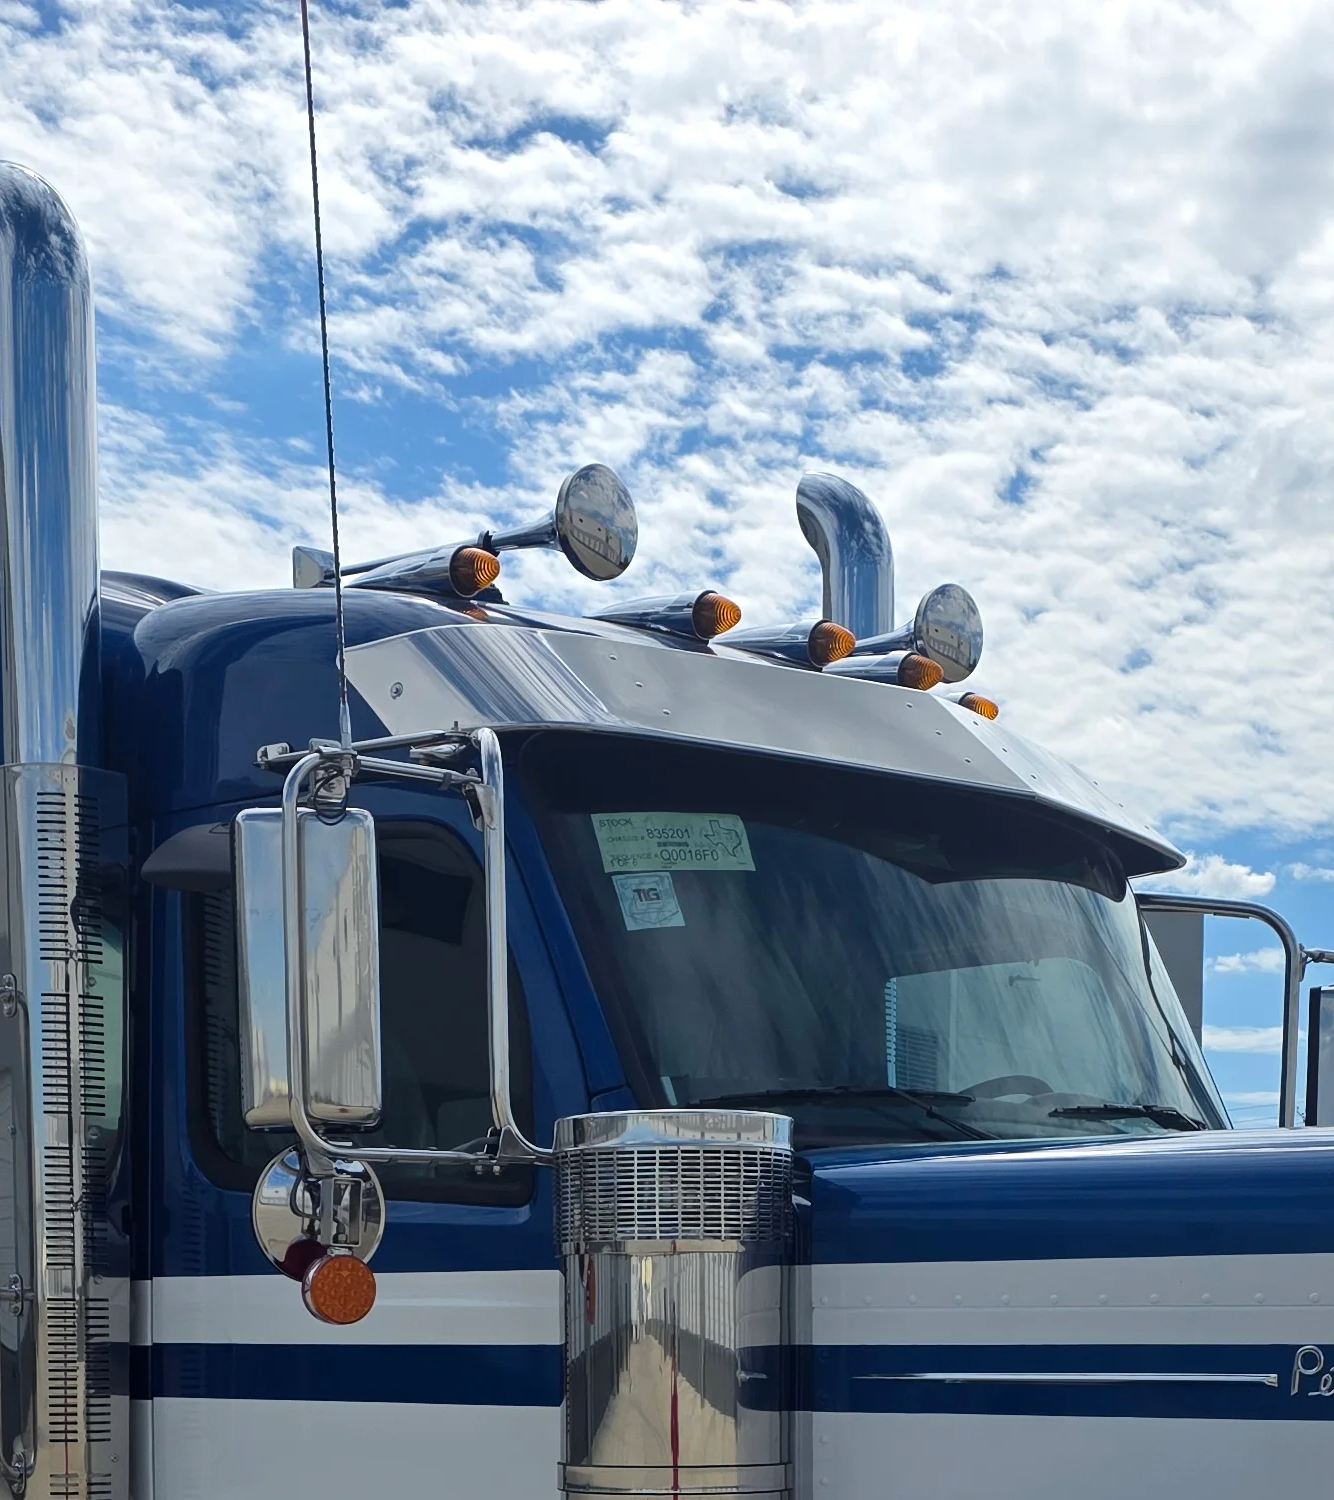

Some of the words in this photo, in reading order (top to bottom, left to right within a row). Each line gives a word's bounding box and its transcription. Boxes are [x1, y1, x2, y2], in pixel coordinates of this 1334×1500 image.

[599, 818, 633, 828] STOCK
[646, 828, 690, 839] 835201
[660, 849, 719, 862] Q0016F0
